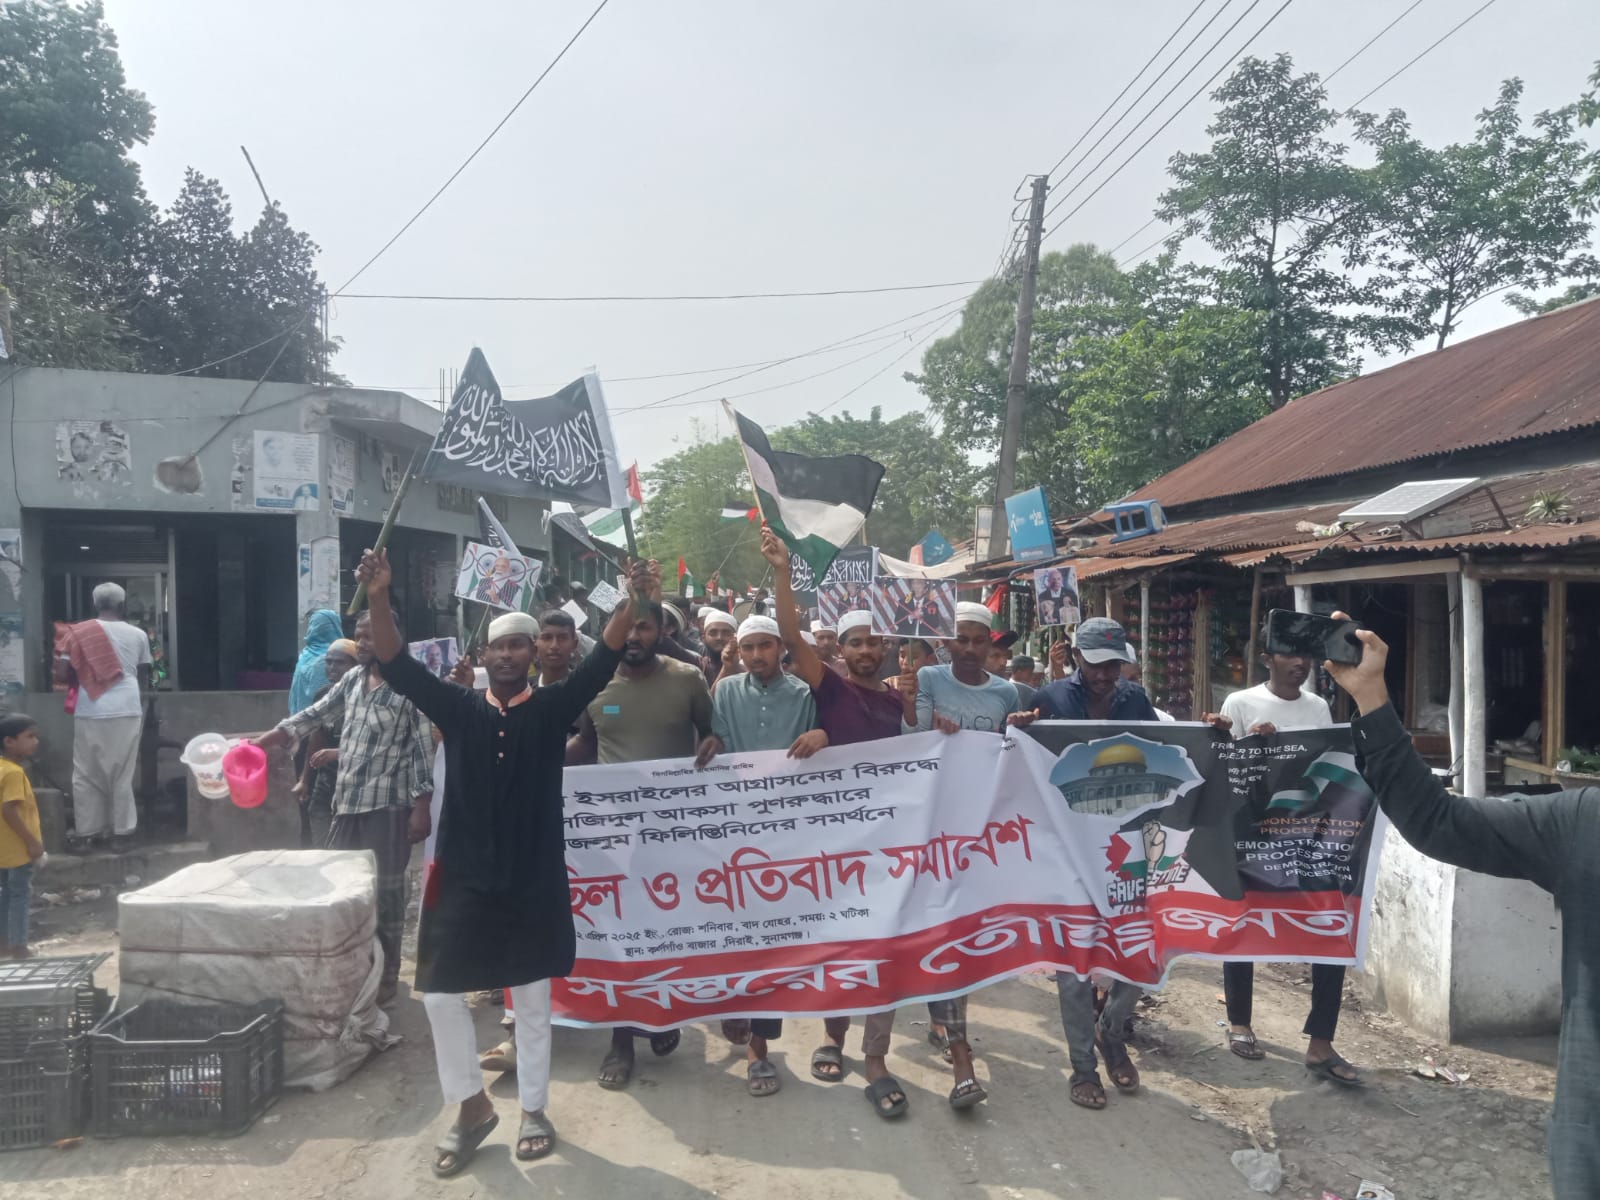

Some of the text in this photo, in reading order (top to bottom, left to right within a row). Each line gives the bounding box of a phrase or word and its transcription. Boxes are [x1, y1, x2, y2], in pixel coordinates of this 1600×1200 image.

[1263, 746, 1282, 755] THE
[574, 784, 709, 807] ইসরাইলের
[715, 768, 846, 793] আগ্রাসনের
[851, 757, 942, 780] বিরুদ্ধে
[652, 801, 740, 821] আকসা
[805, 804, 898, 827] সমর্থনে
[641, 871, 681, 911] ও
[694, 846, 874, 913] প্রতিবাদ
[879, 813, 1036, 888] সমাবেশ
[1107, 878, 1145, 904] SAVE
[611, 931, 641, 941] ২০২৫
[741, 919, 760, 931] বাদ
[829, 911, 838, 920] ২
[840, 907, 870, 919] ঘটিকা
[686, 939, 717, 951] বাজার
[564, 959, 893, 1009] সর্বস্তরের
